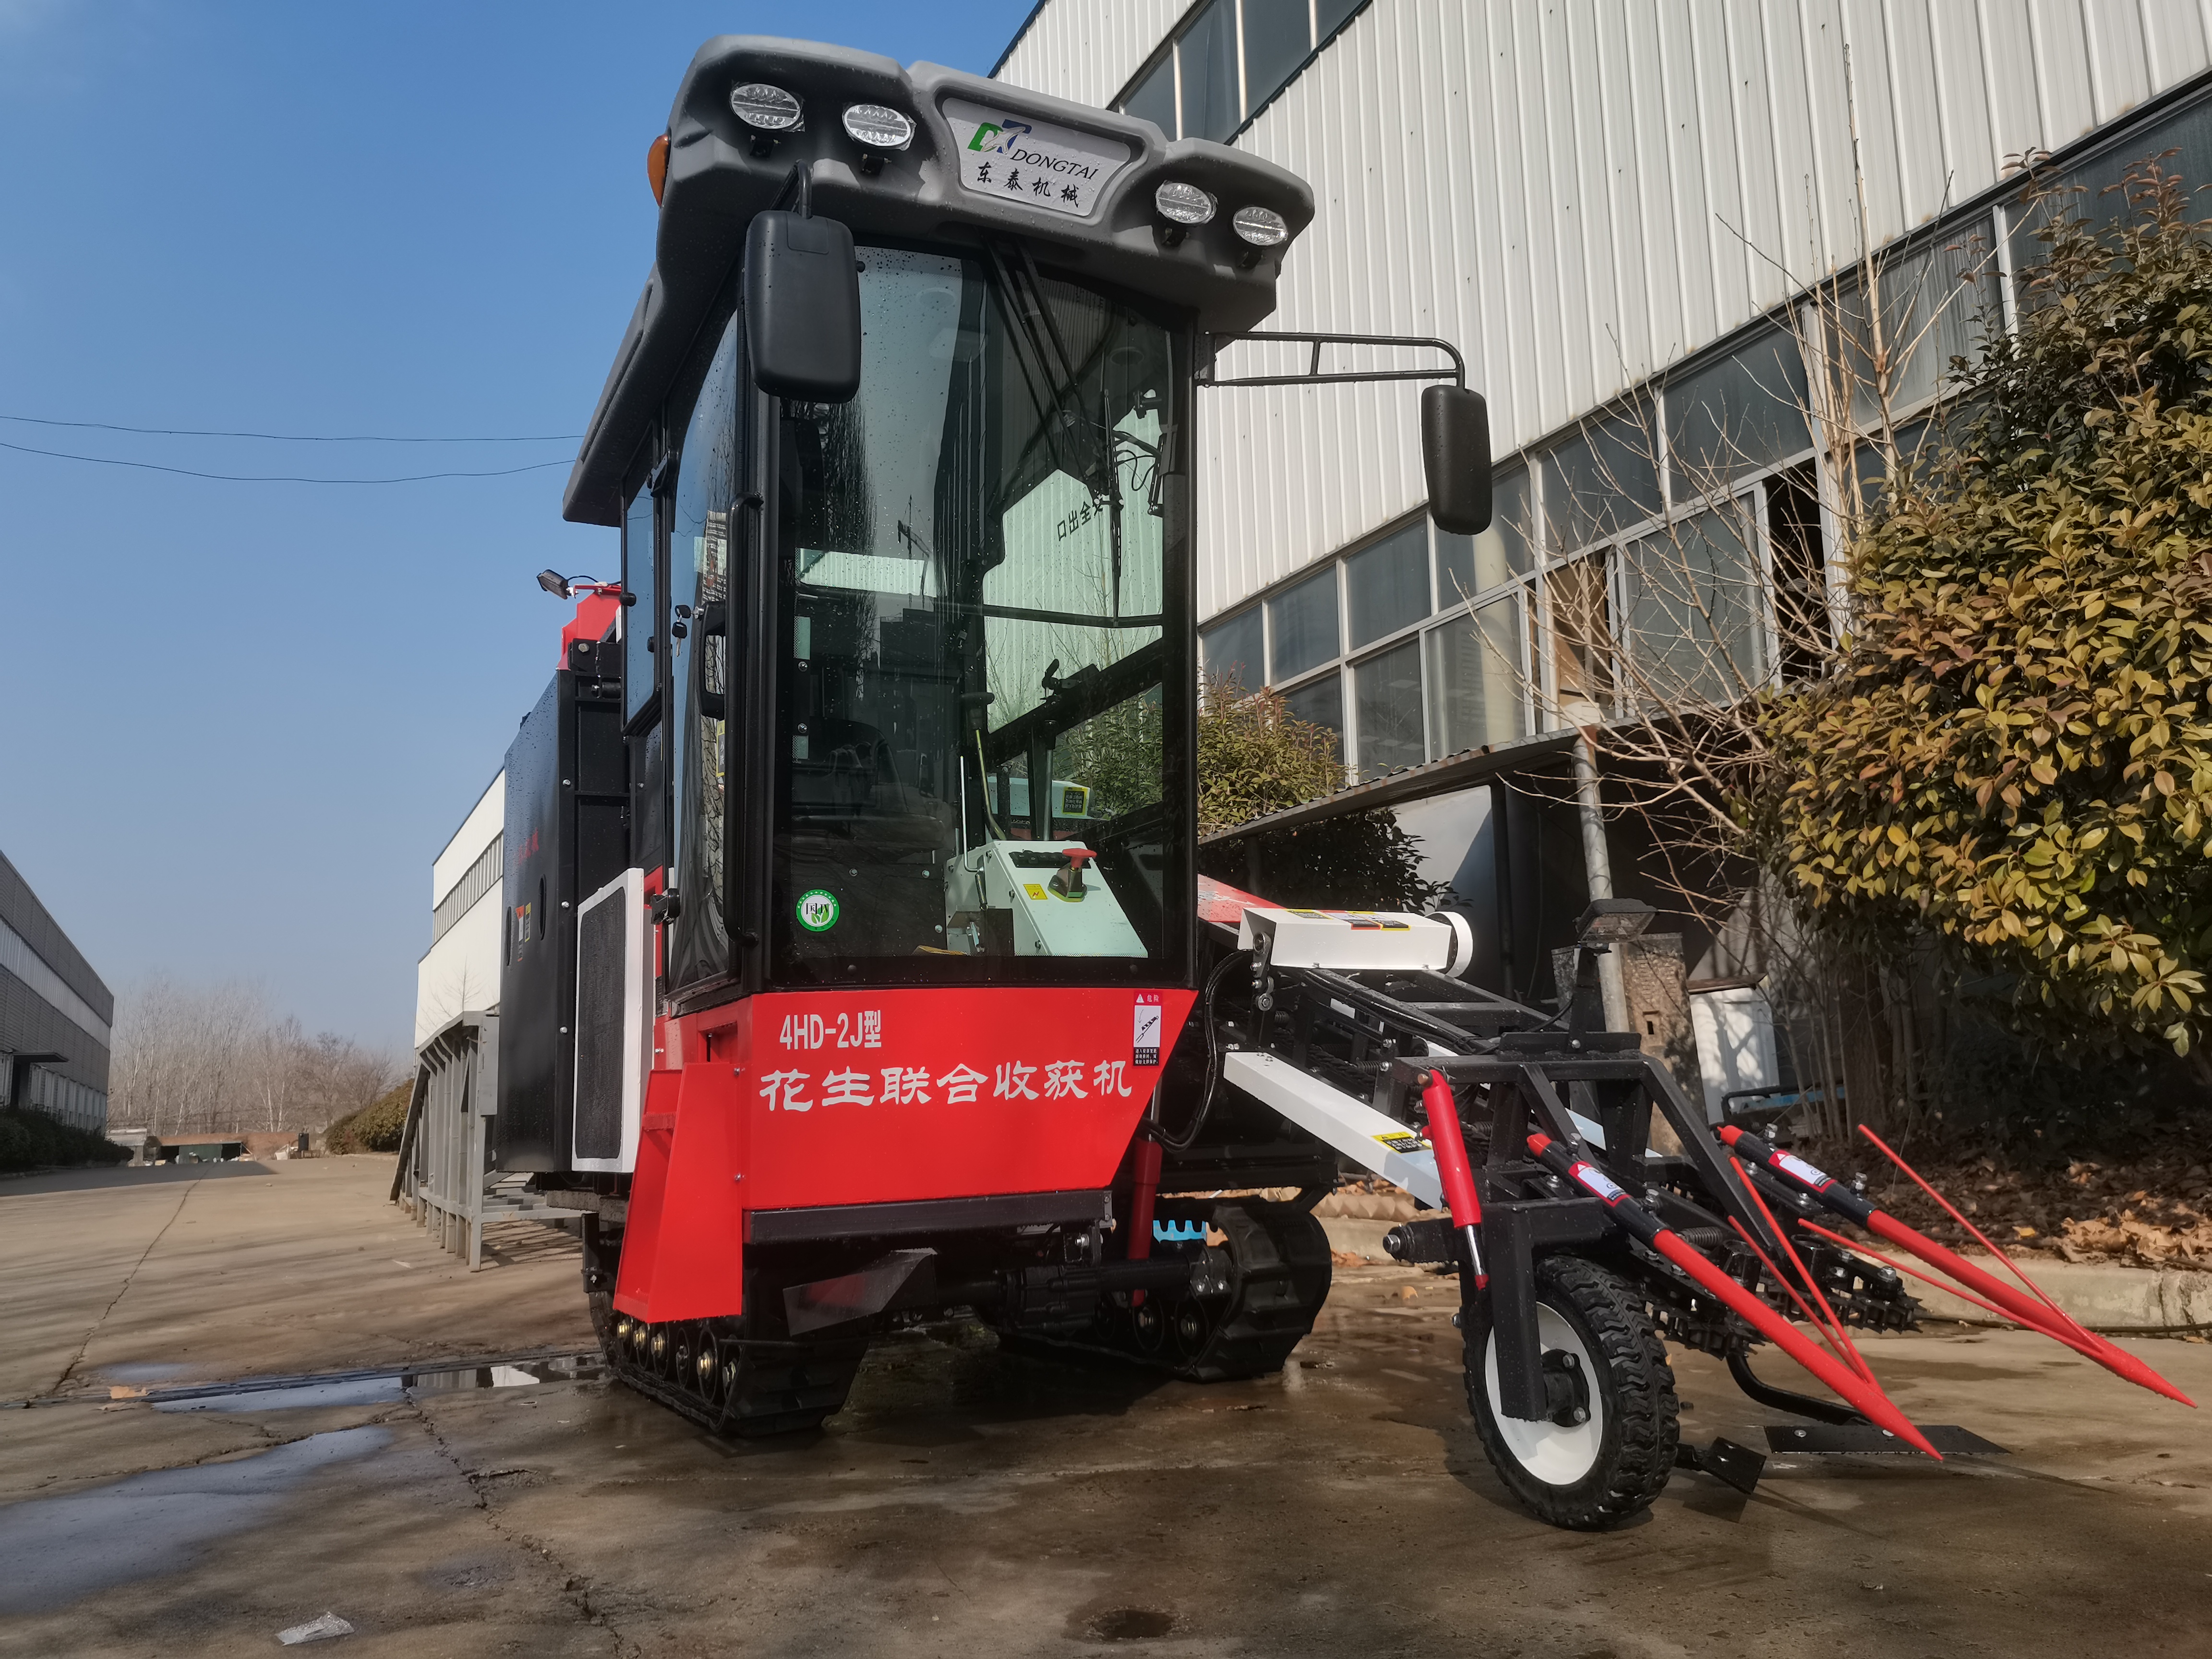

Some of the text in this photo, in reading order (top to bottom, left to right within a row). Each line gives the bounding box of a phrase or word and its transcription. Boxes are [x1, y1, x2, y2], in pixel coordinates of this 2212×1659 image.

[976, 161, 1079, 208] 东泰机械
[1010, 148, 1099, 180] DONGTAI
[780, 1010, 882, 1050] 4HD-2J型
[759, 1060, 1132, 1112] 花生联合收获机
